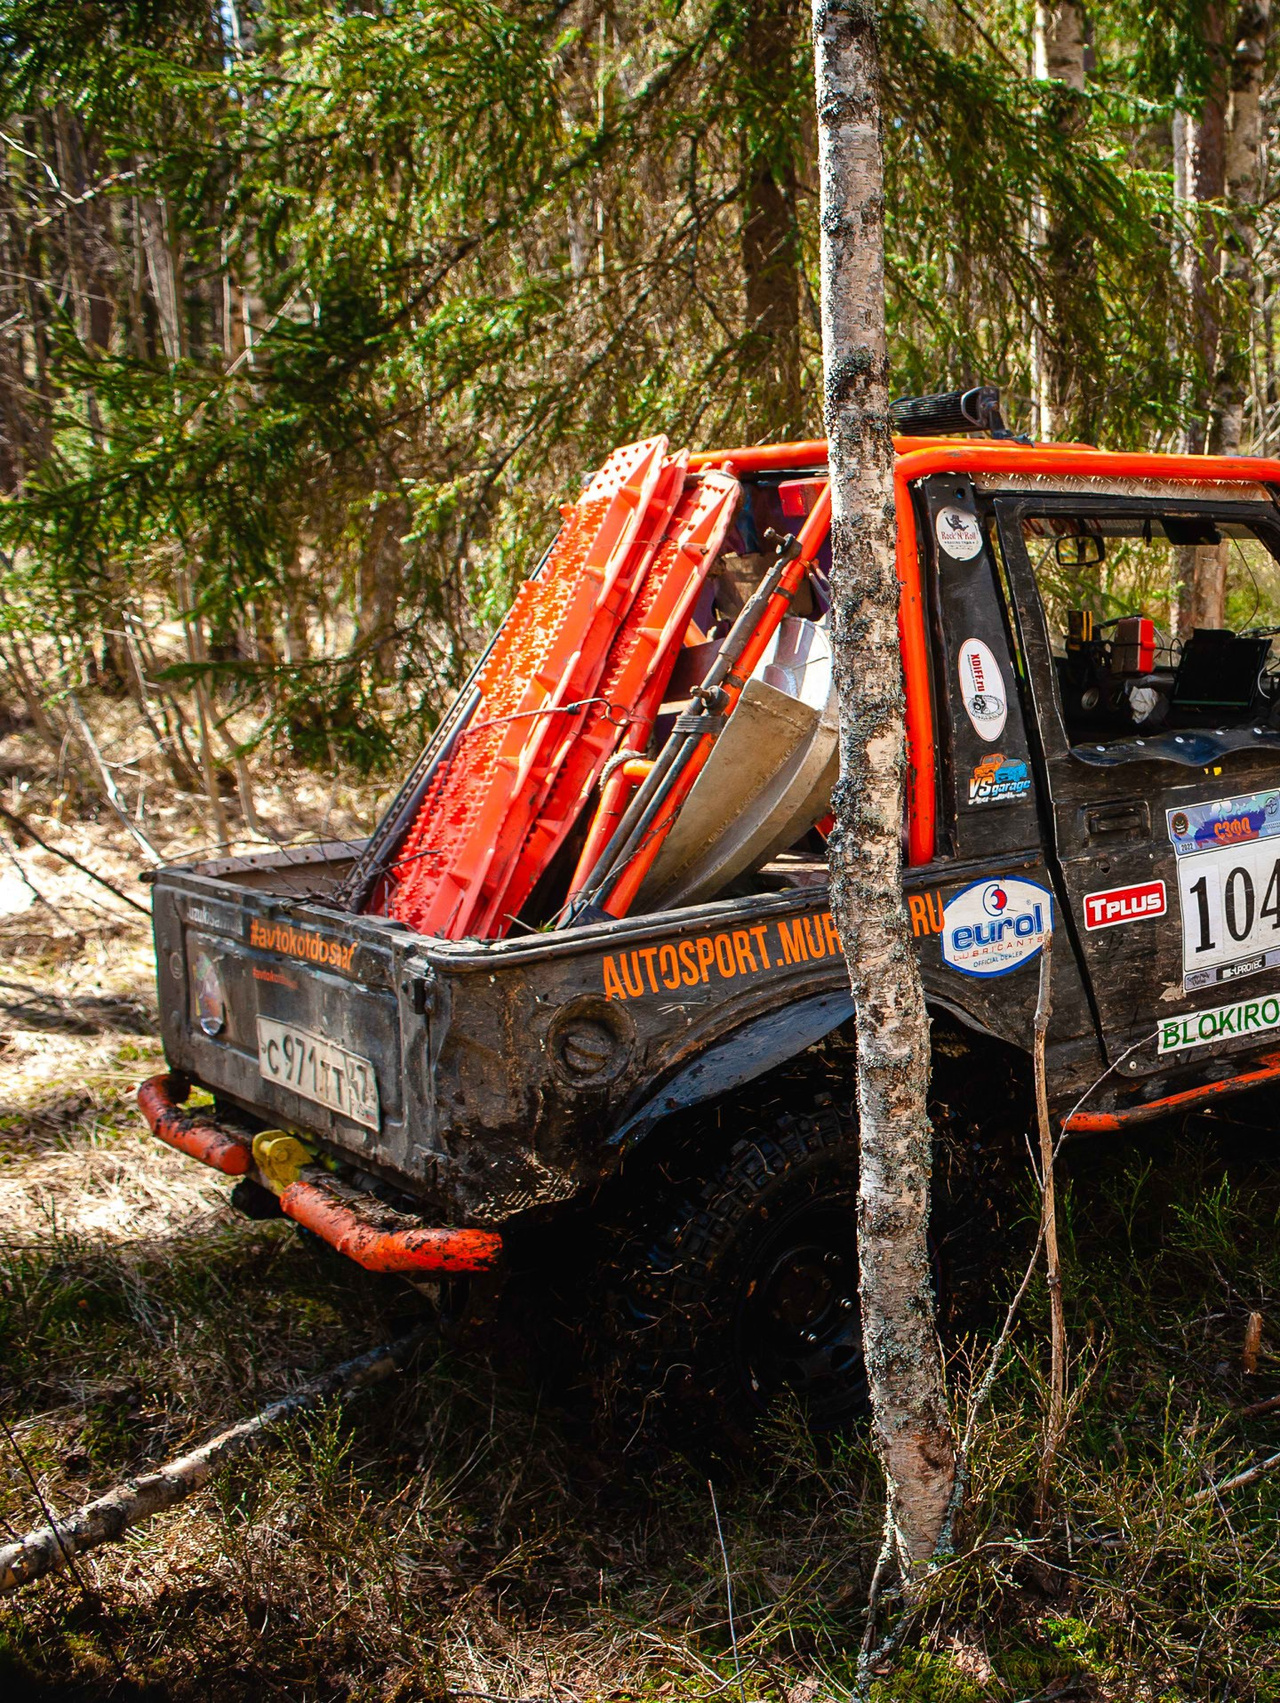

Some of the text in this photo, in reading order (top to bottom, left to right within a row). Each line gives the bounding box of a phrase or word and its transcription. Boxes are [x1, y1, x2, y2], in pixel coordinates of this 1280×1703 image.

[969, 777, 1031, 798] VS garage
[1181, 843, 1194, 852] 2022
[1089, 892, 1162, 922] TPLUS
[952, 903, 1044, 951] eurol
[953, 936, 1044, 962] LUBRICANTS
[973, 950, 1023, 968] OFFICIAL DEALER
